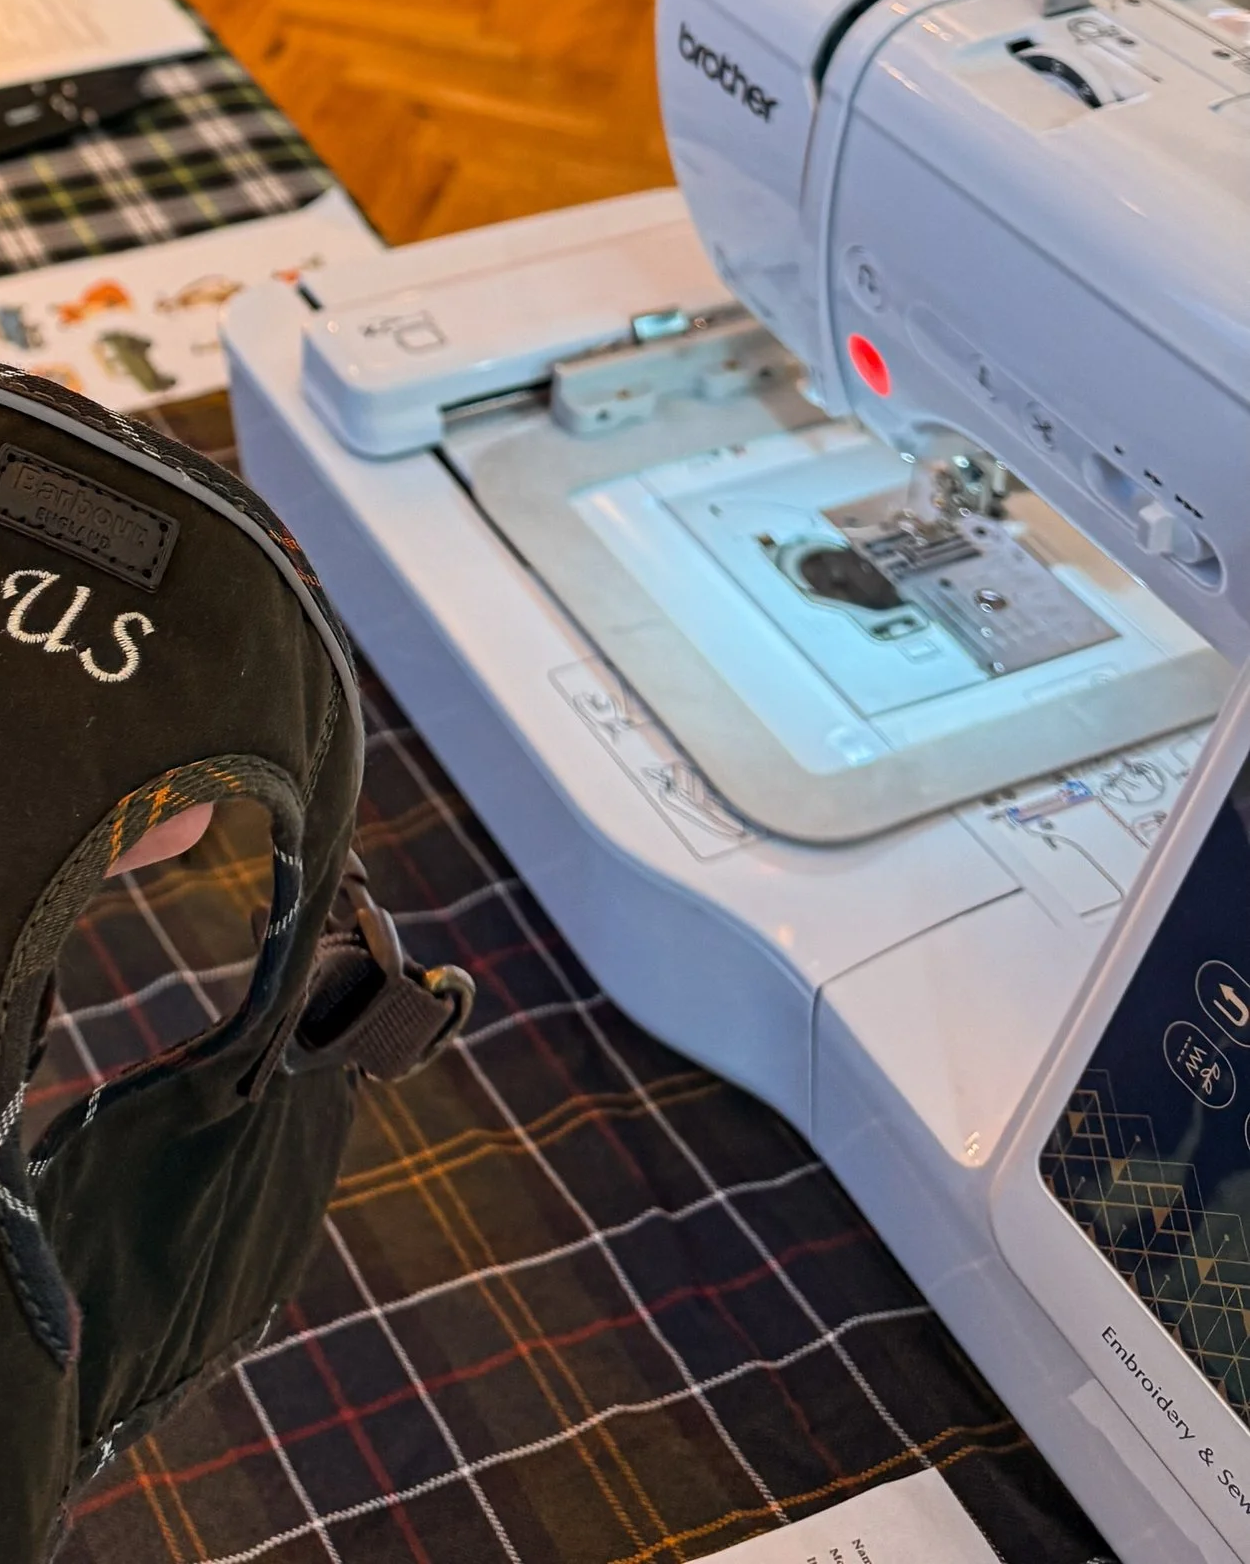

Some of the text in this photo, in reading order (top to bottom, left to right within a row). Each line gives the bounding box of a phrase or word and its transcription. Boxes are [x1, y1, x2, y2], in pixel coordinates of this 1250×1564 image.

[679, 22, 778, 124] brother
[34, 506, 111, 549] ENGLAND
[1101, 1326, 1195, 1440] Embroidery
[1198, 1448, 1214, 1467] &
